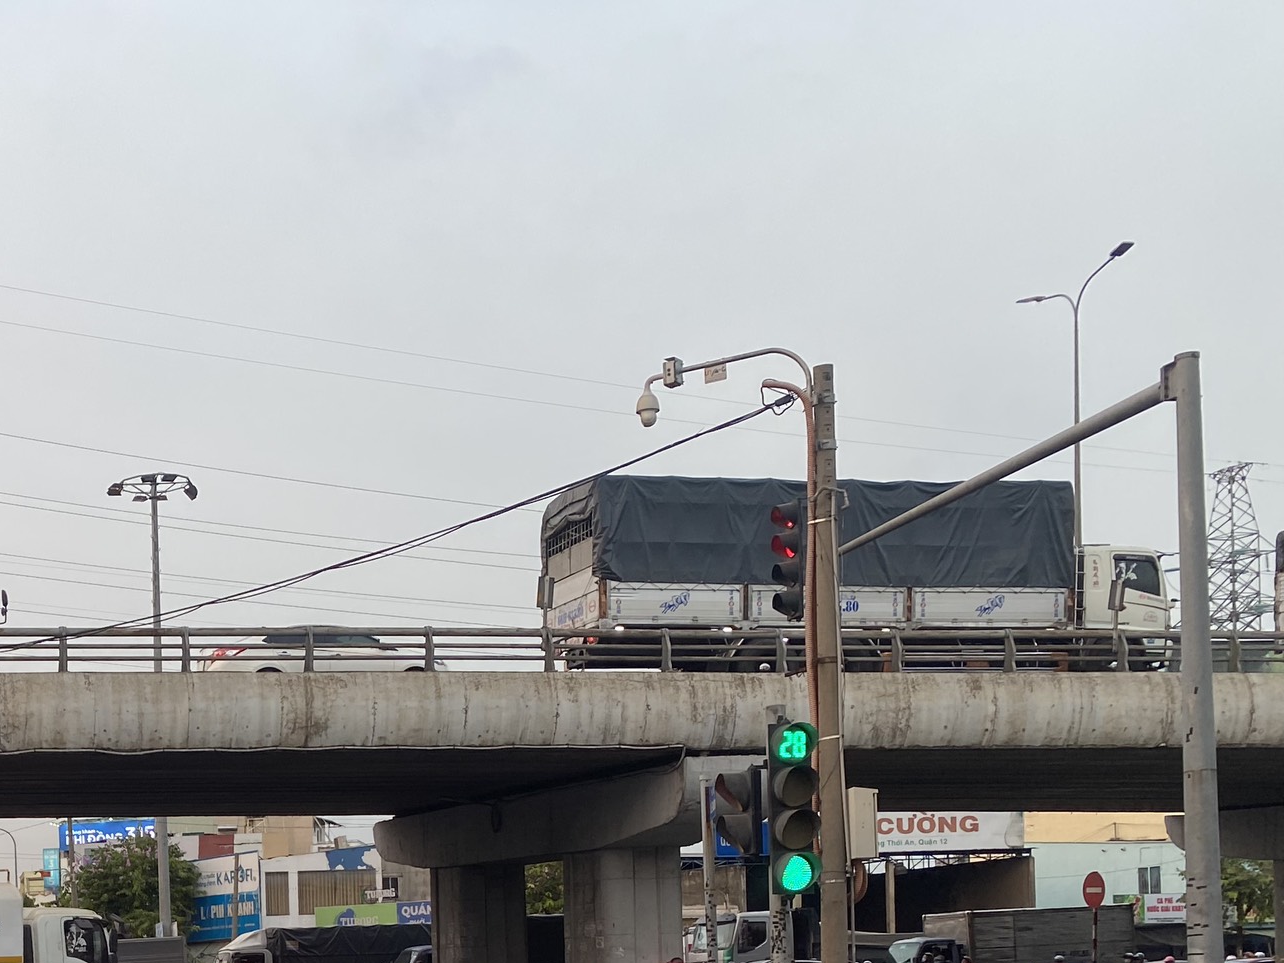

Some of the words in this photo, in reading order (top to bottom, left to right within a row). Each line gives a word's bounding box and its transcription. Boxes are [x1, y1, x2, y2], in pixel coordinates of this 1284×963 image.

[779, 731, 806, 758] 28
[125, 825, 155, 839] 315
[876, 812, 980, 835] CƯỜNG
[365, 888, 396, 900] TUBORG
